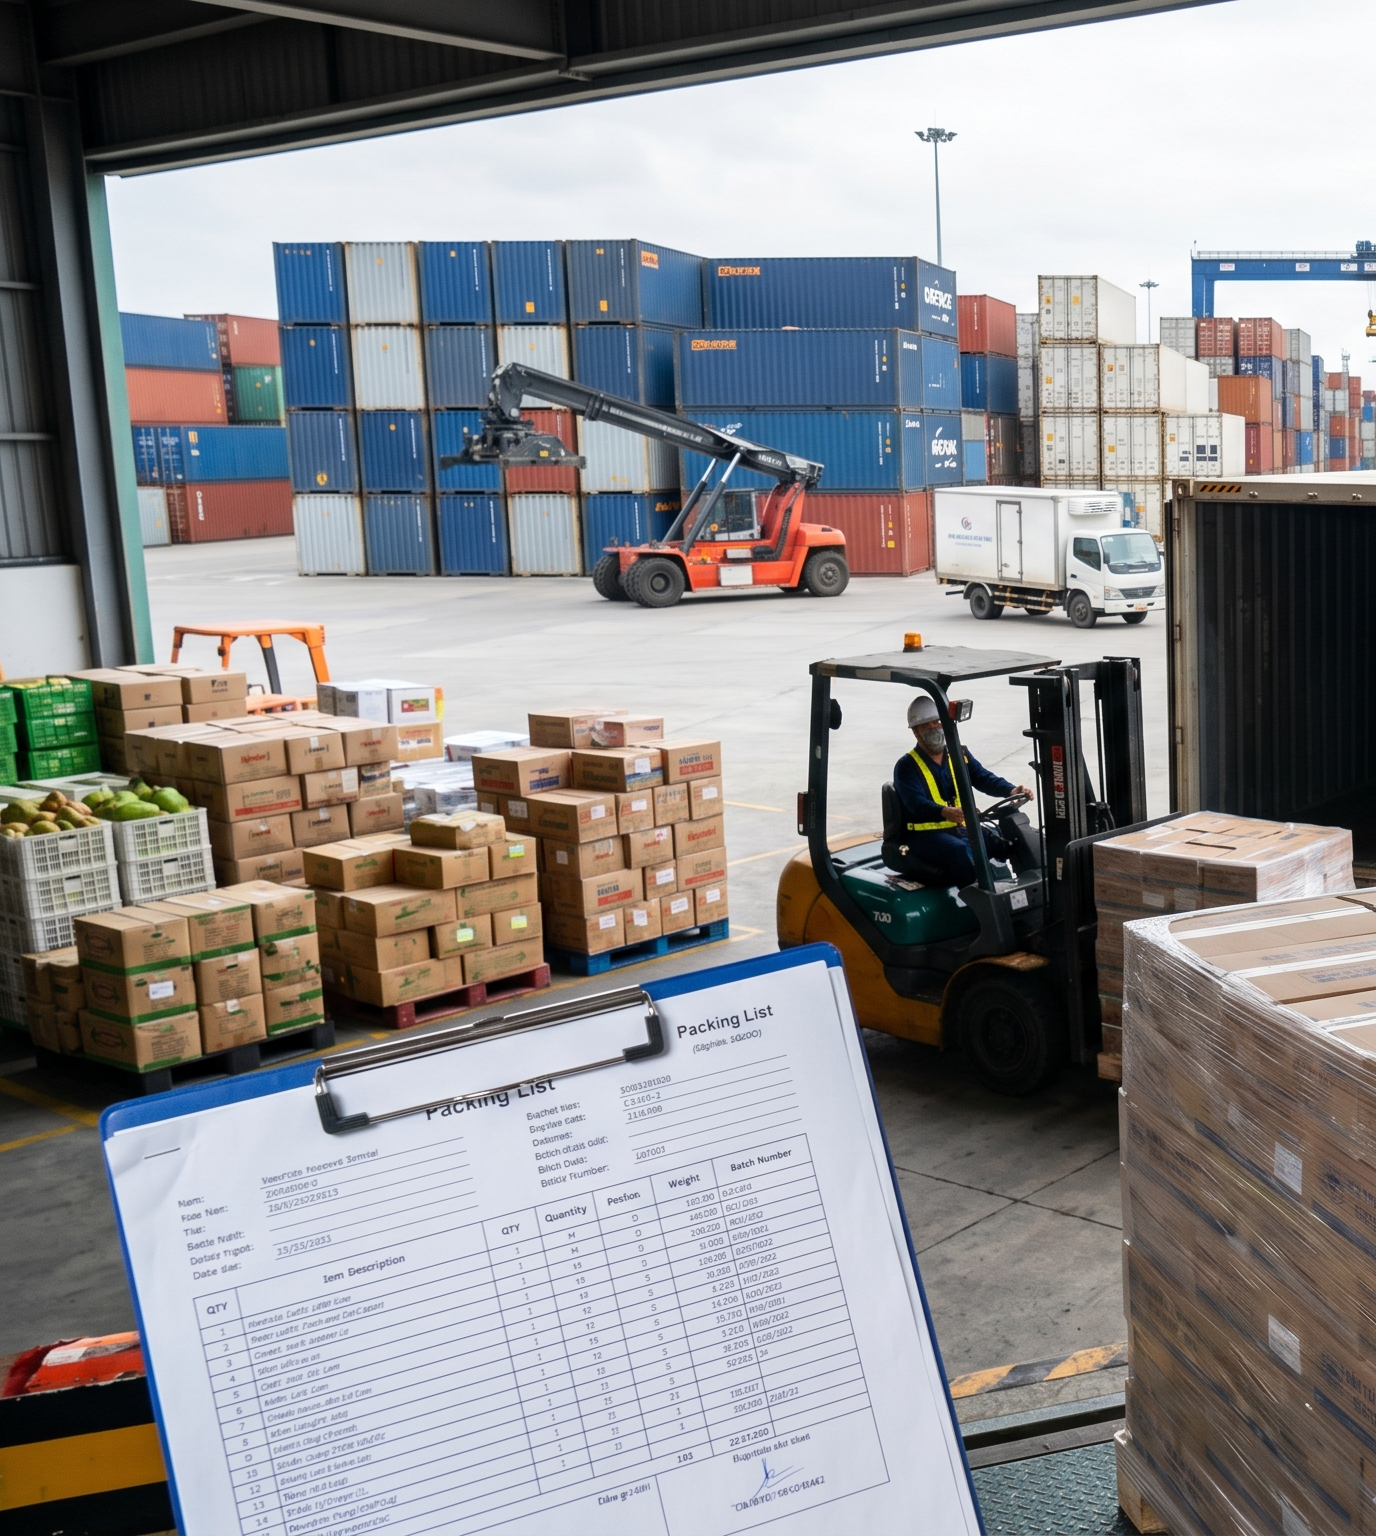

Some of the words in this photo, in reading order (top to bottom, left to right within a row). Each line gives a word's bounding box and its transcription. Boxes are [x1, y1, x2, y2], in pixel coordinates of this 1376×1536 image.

[676, 1014, 740, 1039] Packing
[743, 1004, 773, 1022] List
[730, 1158, 755, 1172] Batch
[757, 1149, 792, 1164] Number
[667, 1174, 700, 1188] Weight
[544, 1206, 587, 1222] Quantity
[501, 1223, 520, 1235] QTY
[347, 1255, 405, 1277] Description
[192, 1268, 218, 1280] Date
[206, 1301, 227, 1315] QTY
[222, 1343, 230, 1352] 2
[226, 1358, 233, 1368] 3
[238, 1421, 245, 1431] 7
[677, 1451, 694, 1463] 103
